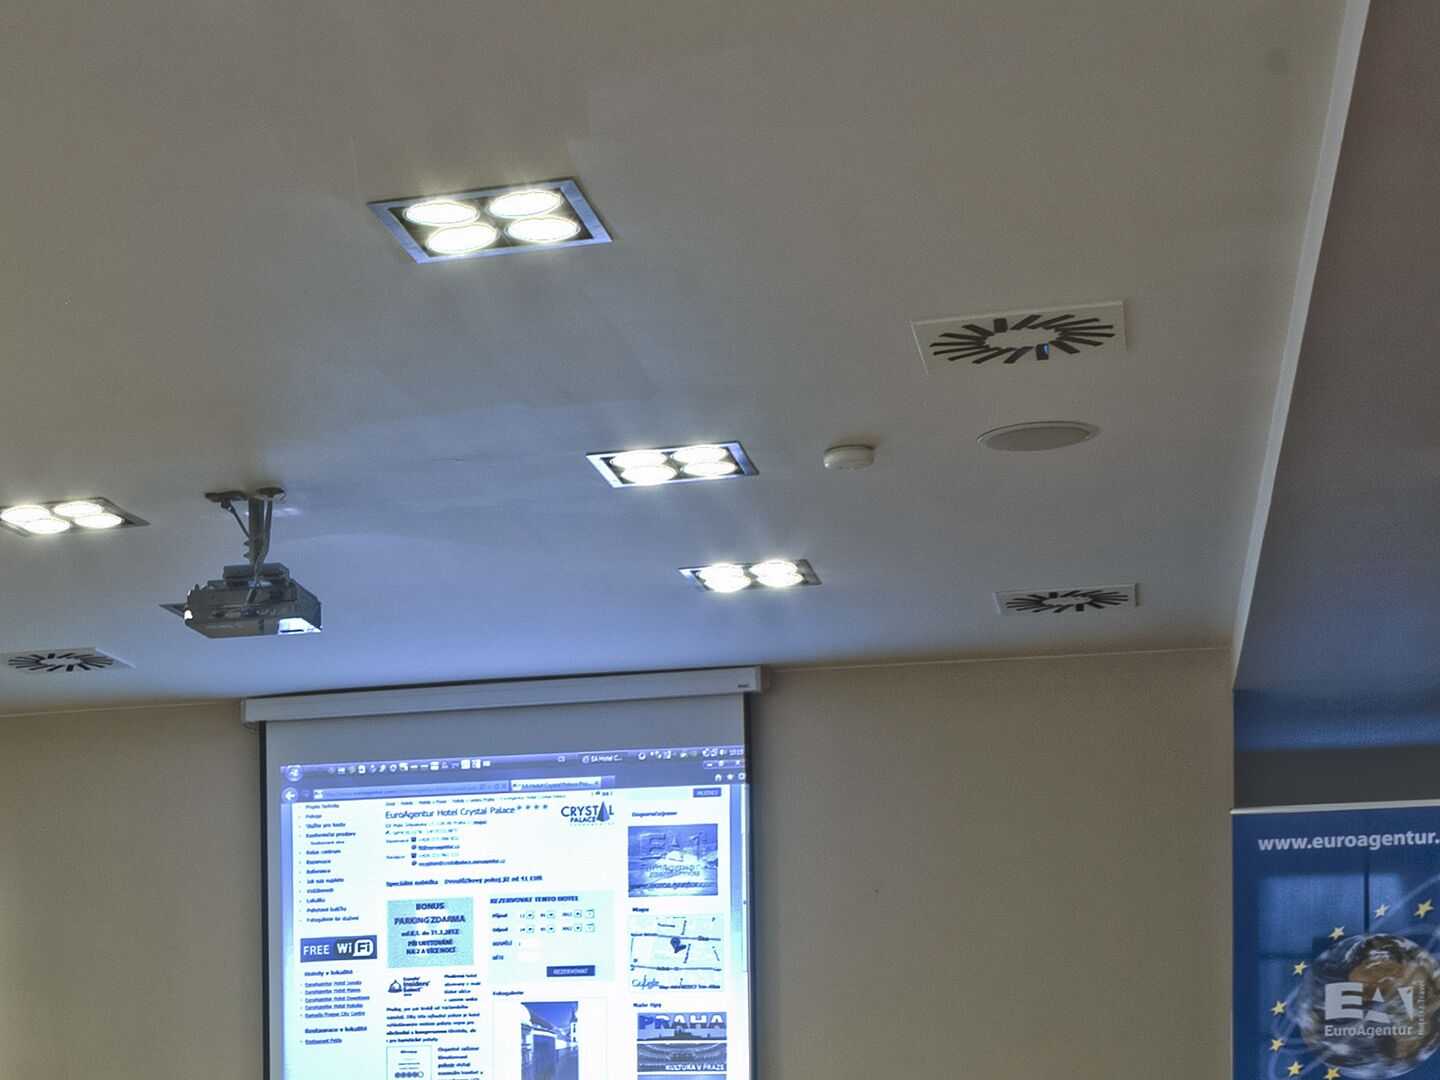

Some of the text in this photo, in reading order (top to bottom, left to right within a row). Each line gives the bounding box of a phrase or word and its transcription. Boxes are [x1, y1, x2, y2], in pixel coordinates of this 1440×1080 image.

[385, 806, 515, 820] EuroAgentur Hotel Crystal Palace
[570, 815, 596, 823] PALACE
[416, 902, 445, 910] BONUS
[394, 916, 430, 925] PARKING
[303, 944, 330, 955] FREE
[639, 1015, 726, 1029] PRAHA
[1325, 1024, 1413, 1038] EuroAgentur
